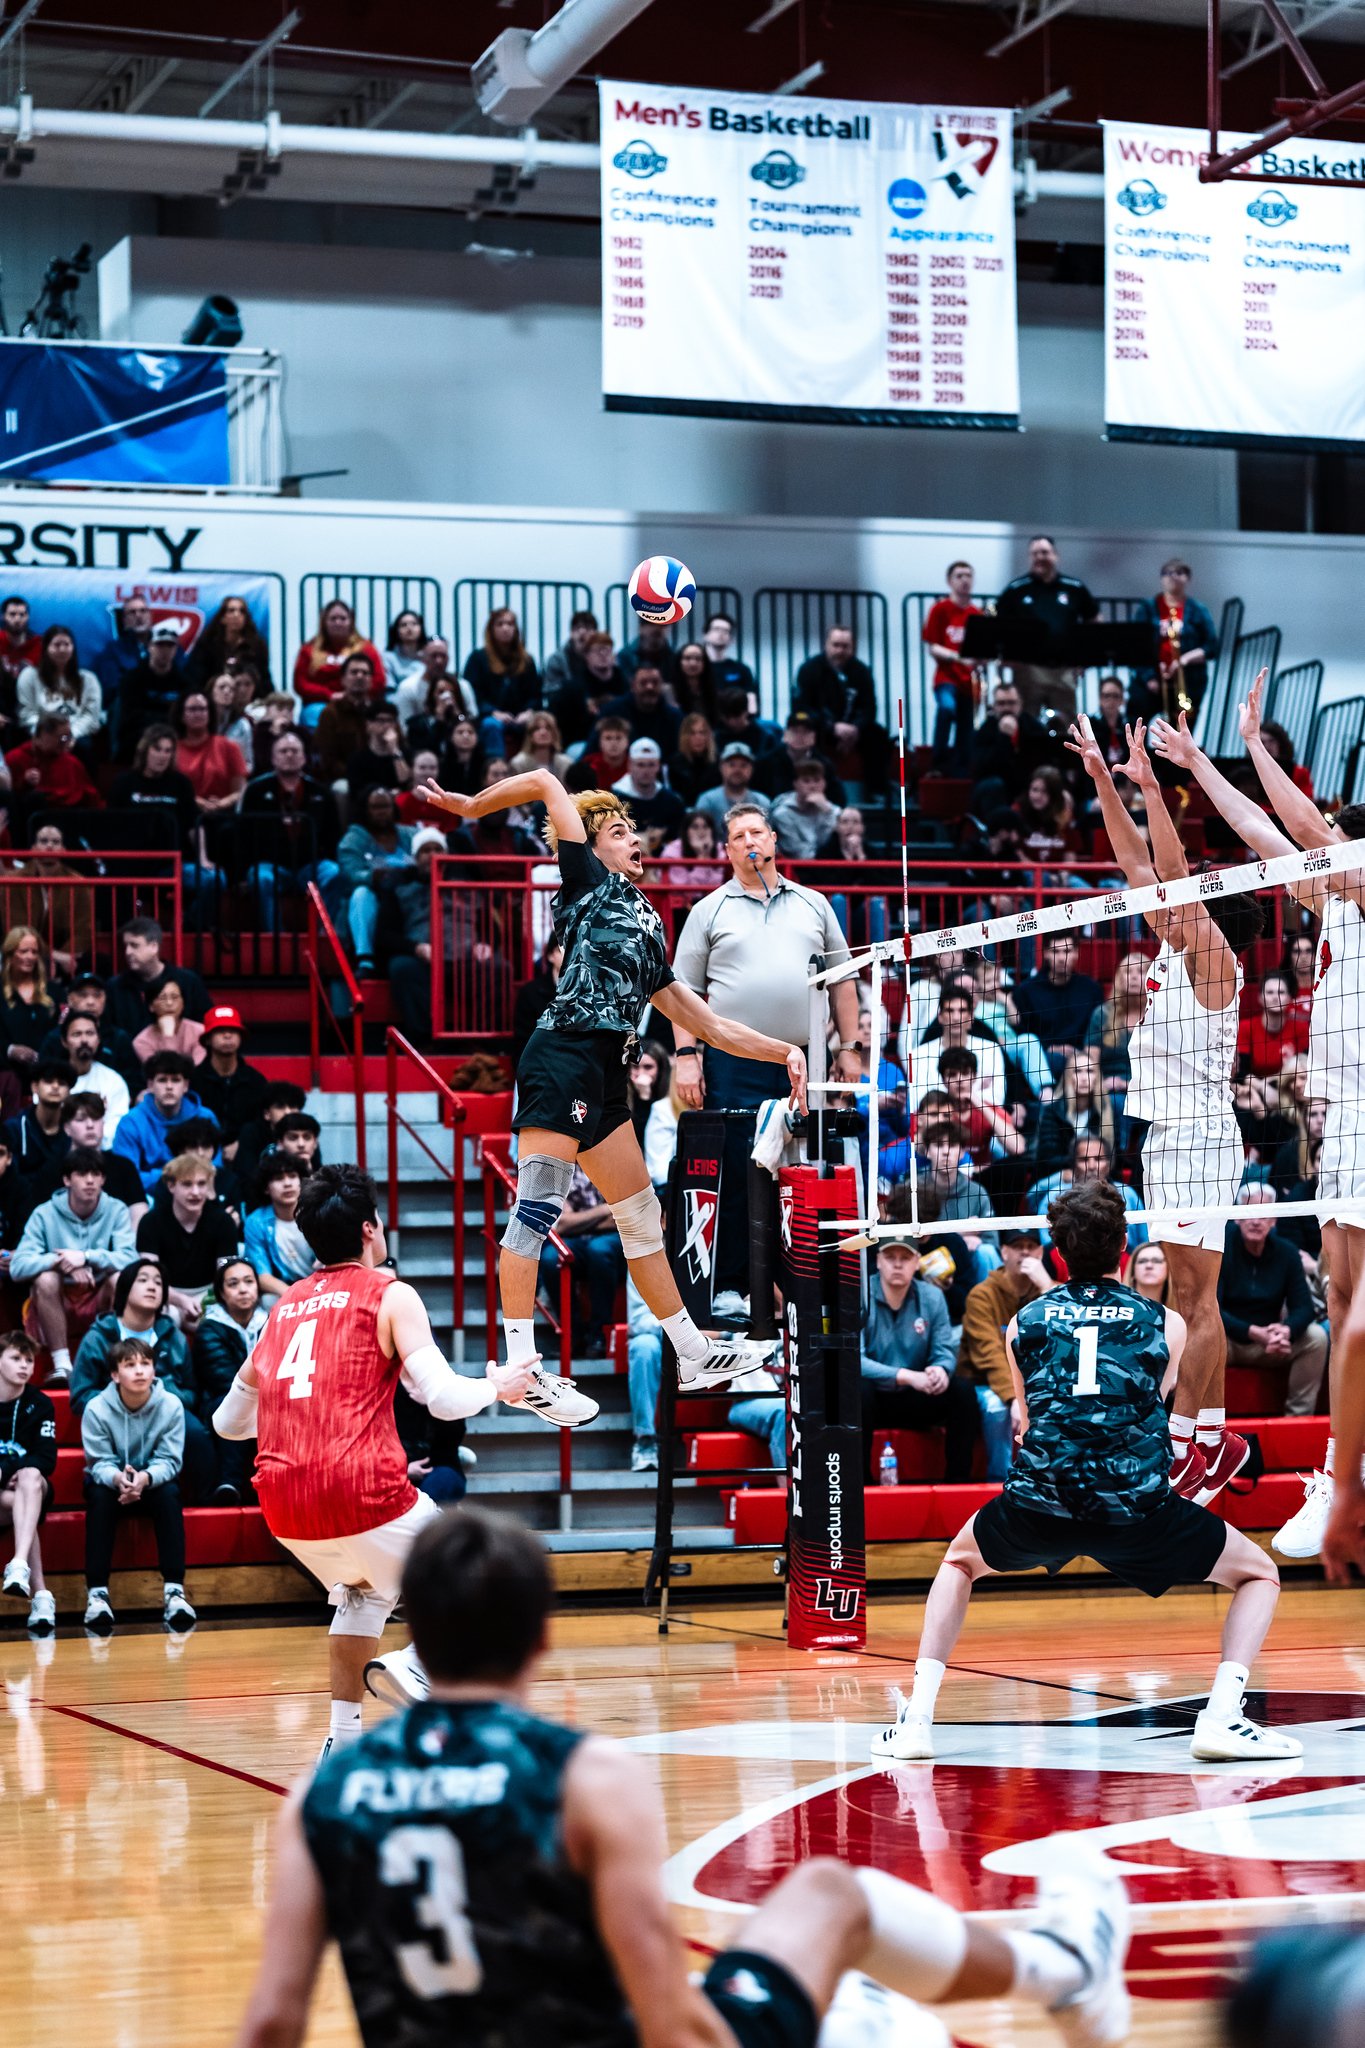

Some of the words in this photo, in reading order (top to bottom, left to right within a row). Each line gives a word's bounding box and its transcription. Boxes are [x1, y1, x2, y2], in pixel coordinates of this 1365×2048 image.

[616, 100, 702, 128] Men's
[709, 107, 869, 139] Basketball
[610, 188, 718, 208] Conference
[750, 198, 861, 218] Tournament
[610, 208, 714, 228] Champions
[749, 218, 852, 236] Champions
[890, 226, 994, 243] Appearance
[1246, 235, 1350, 255] Tournament
[1244, 254, 1341, 273] Champions
[115, 585, 199, 604] LEWIS
[641, 612, 667, 621] NCAA
[1306, 848, 1326, 861] LEWIS
[1304, 858, 1331, 873] FLYERS
[1200, 872, 1220, 883] LEWIS
[1200, 881, 1224, 895] FLYERS
[1105, 893, 1122, 904] LEWIS
[1018, 912, 1035, 923] LEWIS
[1104, 902, 1127, 915] FLYERS
[1016, 921, 1038, 933] FLYERS
[936, 937, 957, 948] FLYERS
[686, 1158, 719, 1177] LEWIS
[277, 1291, 350, 1323] FLYERS
[1044, 1305, 1135, 1321] FLYERS
[276, 1318, 318, 1400] 4
[1072, 1325, 1101, 1397] 1
[825, 1452, 841, 1504] sports
[827, 1507, 843, 1570] imports
[815, 1578, 860, 1621] LU
[339, 1762, 509, 1814] FLYERS
[379, 1823, 485, 2000] 3
